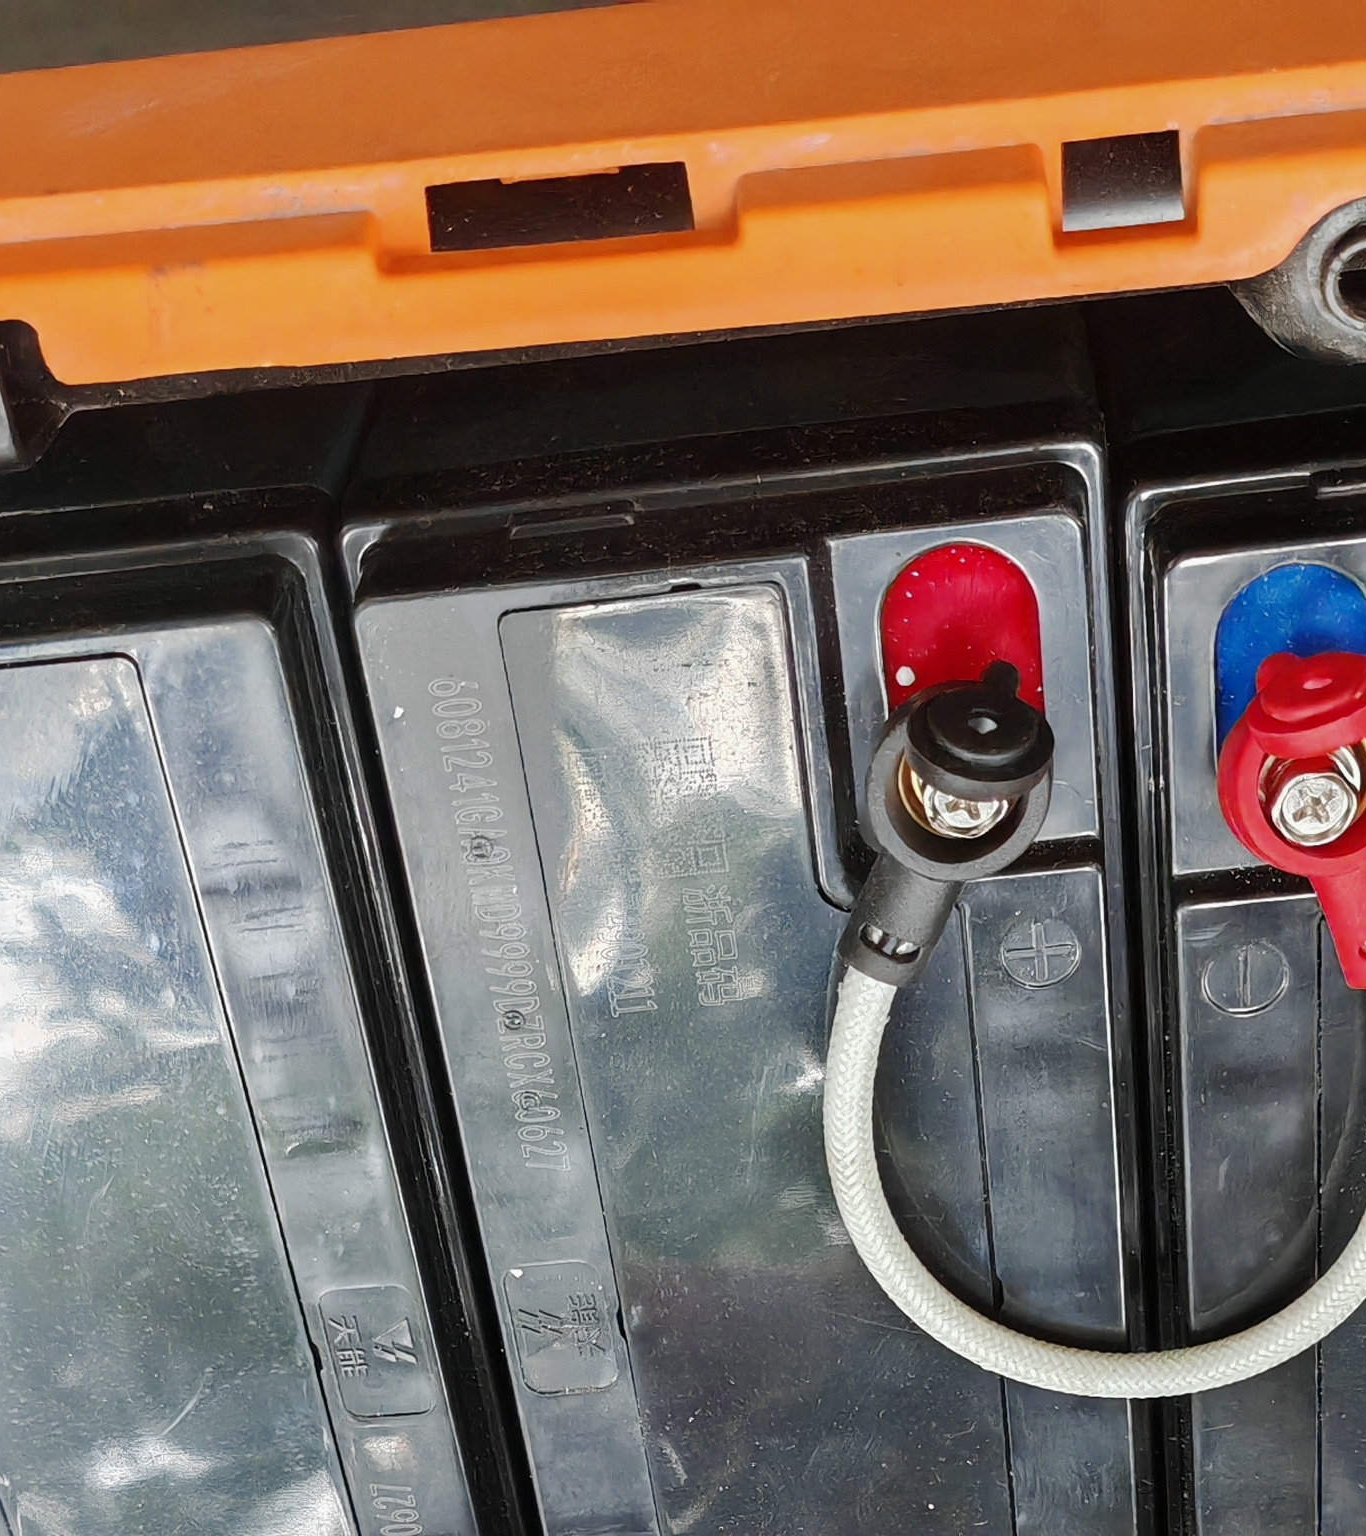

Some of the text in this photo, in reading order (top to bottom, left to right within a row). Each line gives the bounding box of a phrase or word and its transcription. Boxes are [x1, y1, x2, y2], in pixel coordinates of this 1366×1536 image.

[595, 897, 658, 1018] 4901211
[682, 883, 743, 1007] 浙品码
[327, 1311, 370, 1381] 天能
